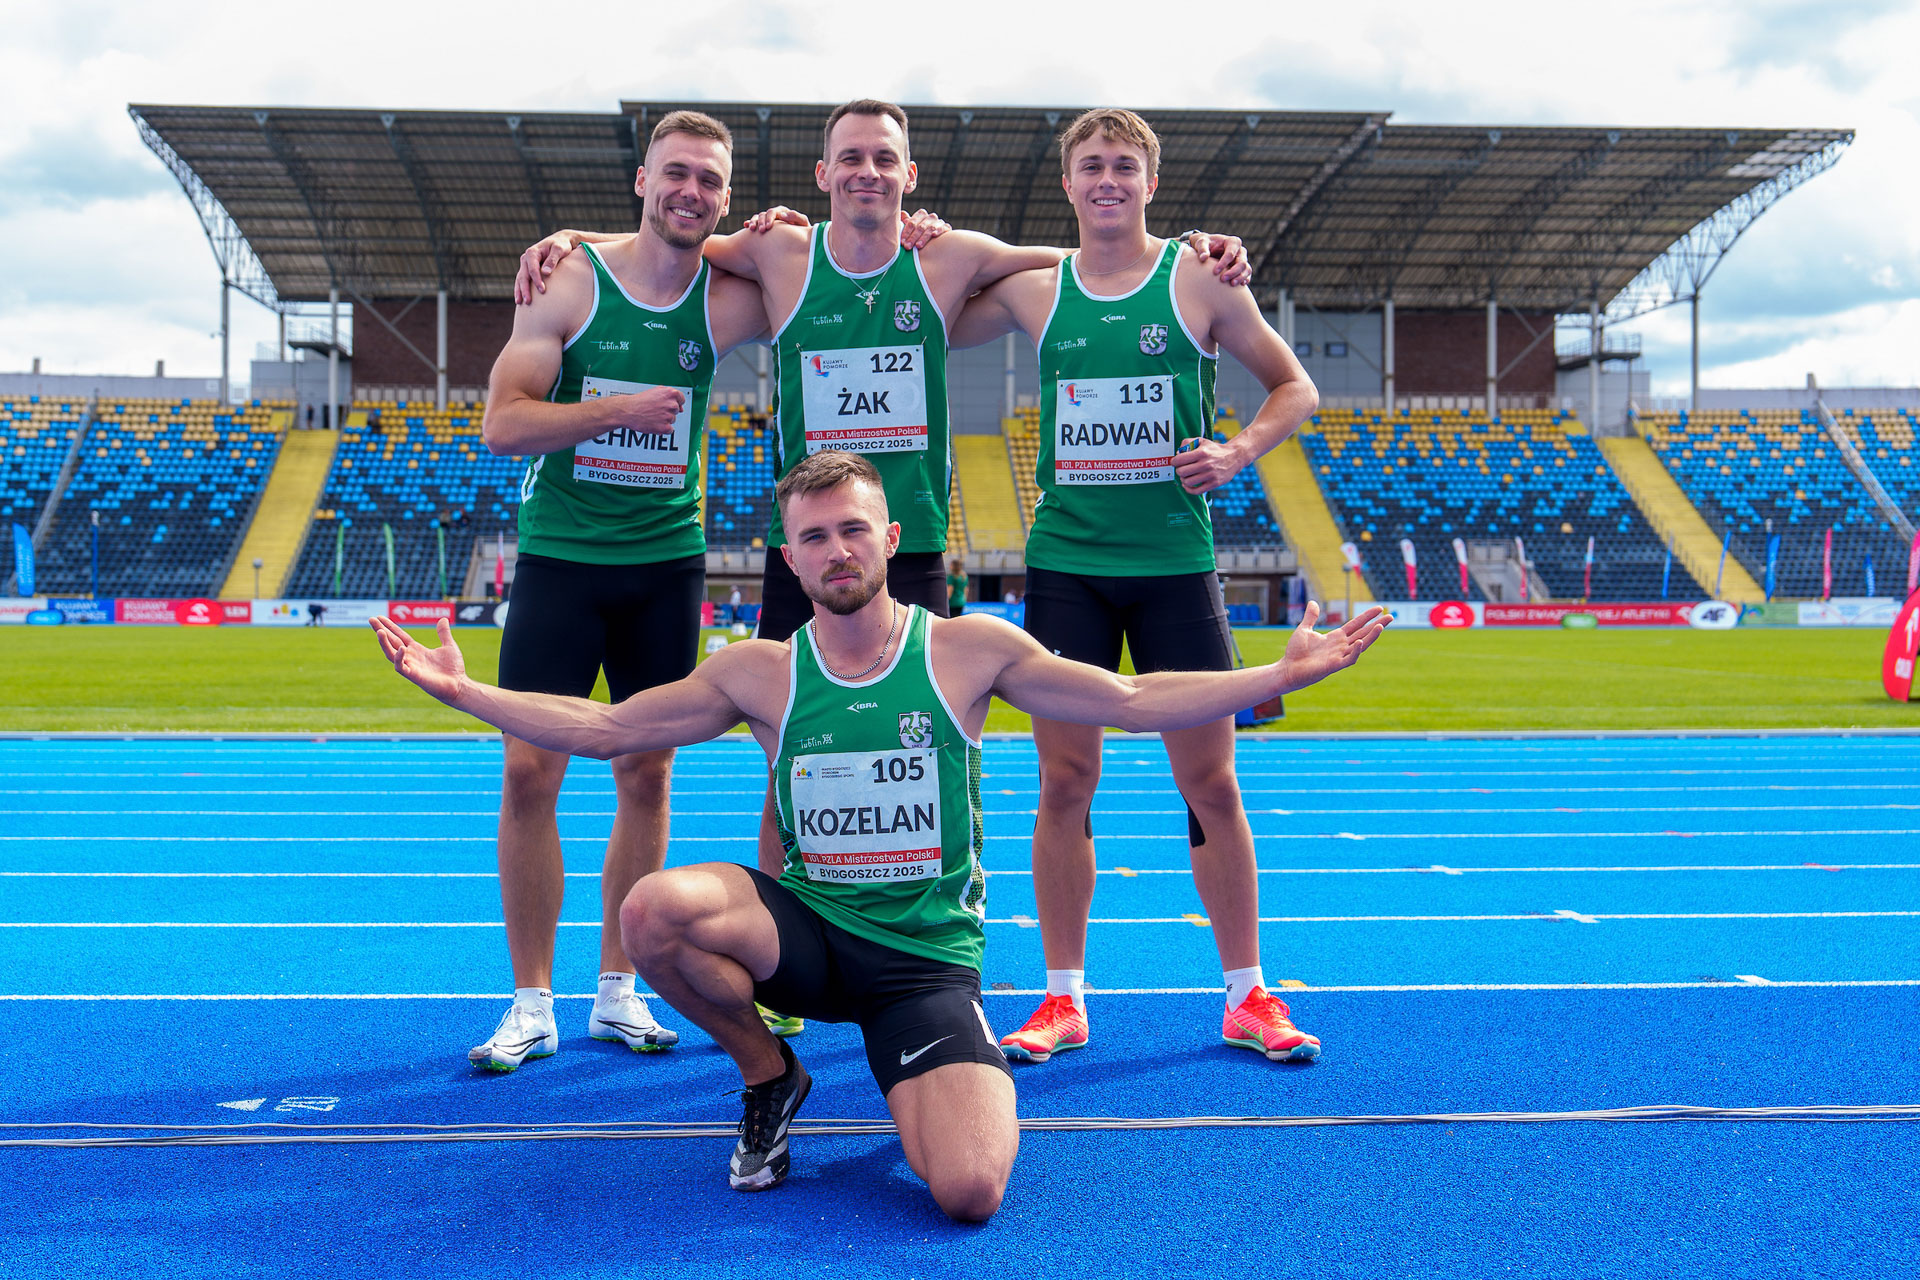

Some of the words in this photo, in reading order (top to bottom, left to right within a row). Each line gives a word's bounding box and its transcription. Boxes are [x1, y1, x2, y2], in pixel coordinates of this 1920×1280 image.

[870, 352, 914, 374] 122
[1119, 382, 1163, 404] 113
[837, 387, 891, 416] ŻAK
[811, 432, 825, 440] 101.
[826, 430, 845, 439] PZLA
[846, 428, 896, 438] Mistrzostwa
[897, 426, 921, 436] Polski
[1061, 420, 1170, 446] RADWAN
[821, 440, 885, 450] BYDGOSZCZ
[887, 439, 913, 448] 2025
[581, 457, 595, 466] 101.
[595, 459, 615, 469] PZLA
[616, 462, 662, 472] Mistrzostwa
[663, 465, 682, 473] Polski
[1061, 461, 1074, 469] 101.
[1075, 461, 1093, 469] PZLA
[1093, 459, 1144, 469] Mistrzostwa
[1145, 457, 1169, 467] Polski
[588, 470, 651, 484] BYDGOSZCZ
[652, 476, 674, 485] 2025
[1069, 472, 1132, 481] BYDGOSZCZ
[1134, 470, 1160, 480] 2025
[225, 606, 249, 617] LEN
[856, 702, 878, 710] IBRA
[871, 756, 925, 784] 105
[799, 802, 935, 836] KOZELAN
[808, 854, 822, 863] 101.
[822, 855, 842, 864] PZLA
[843, 853, 904, 864] Mistrzostwa
[906, 850, 934, 861] Polski
[820, 867, 890, 879] BYDGOSZCZ
[893, 865, 924, 877] 2025
